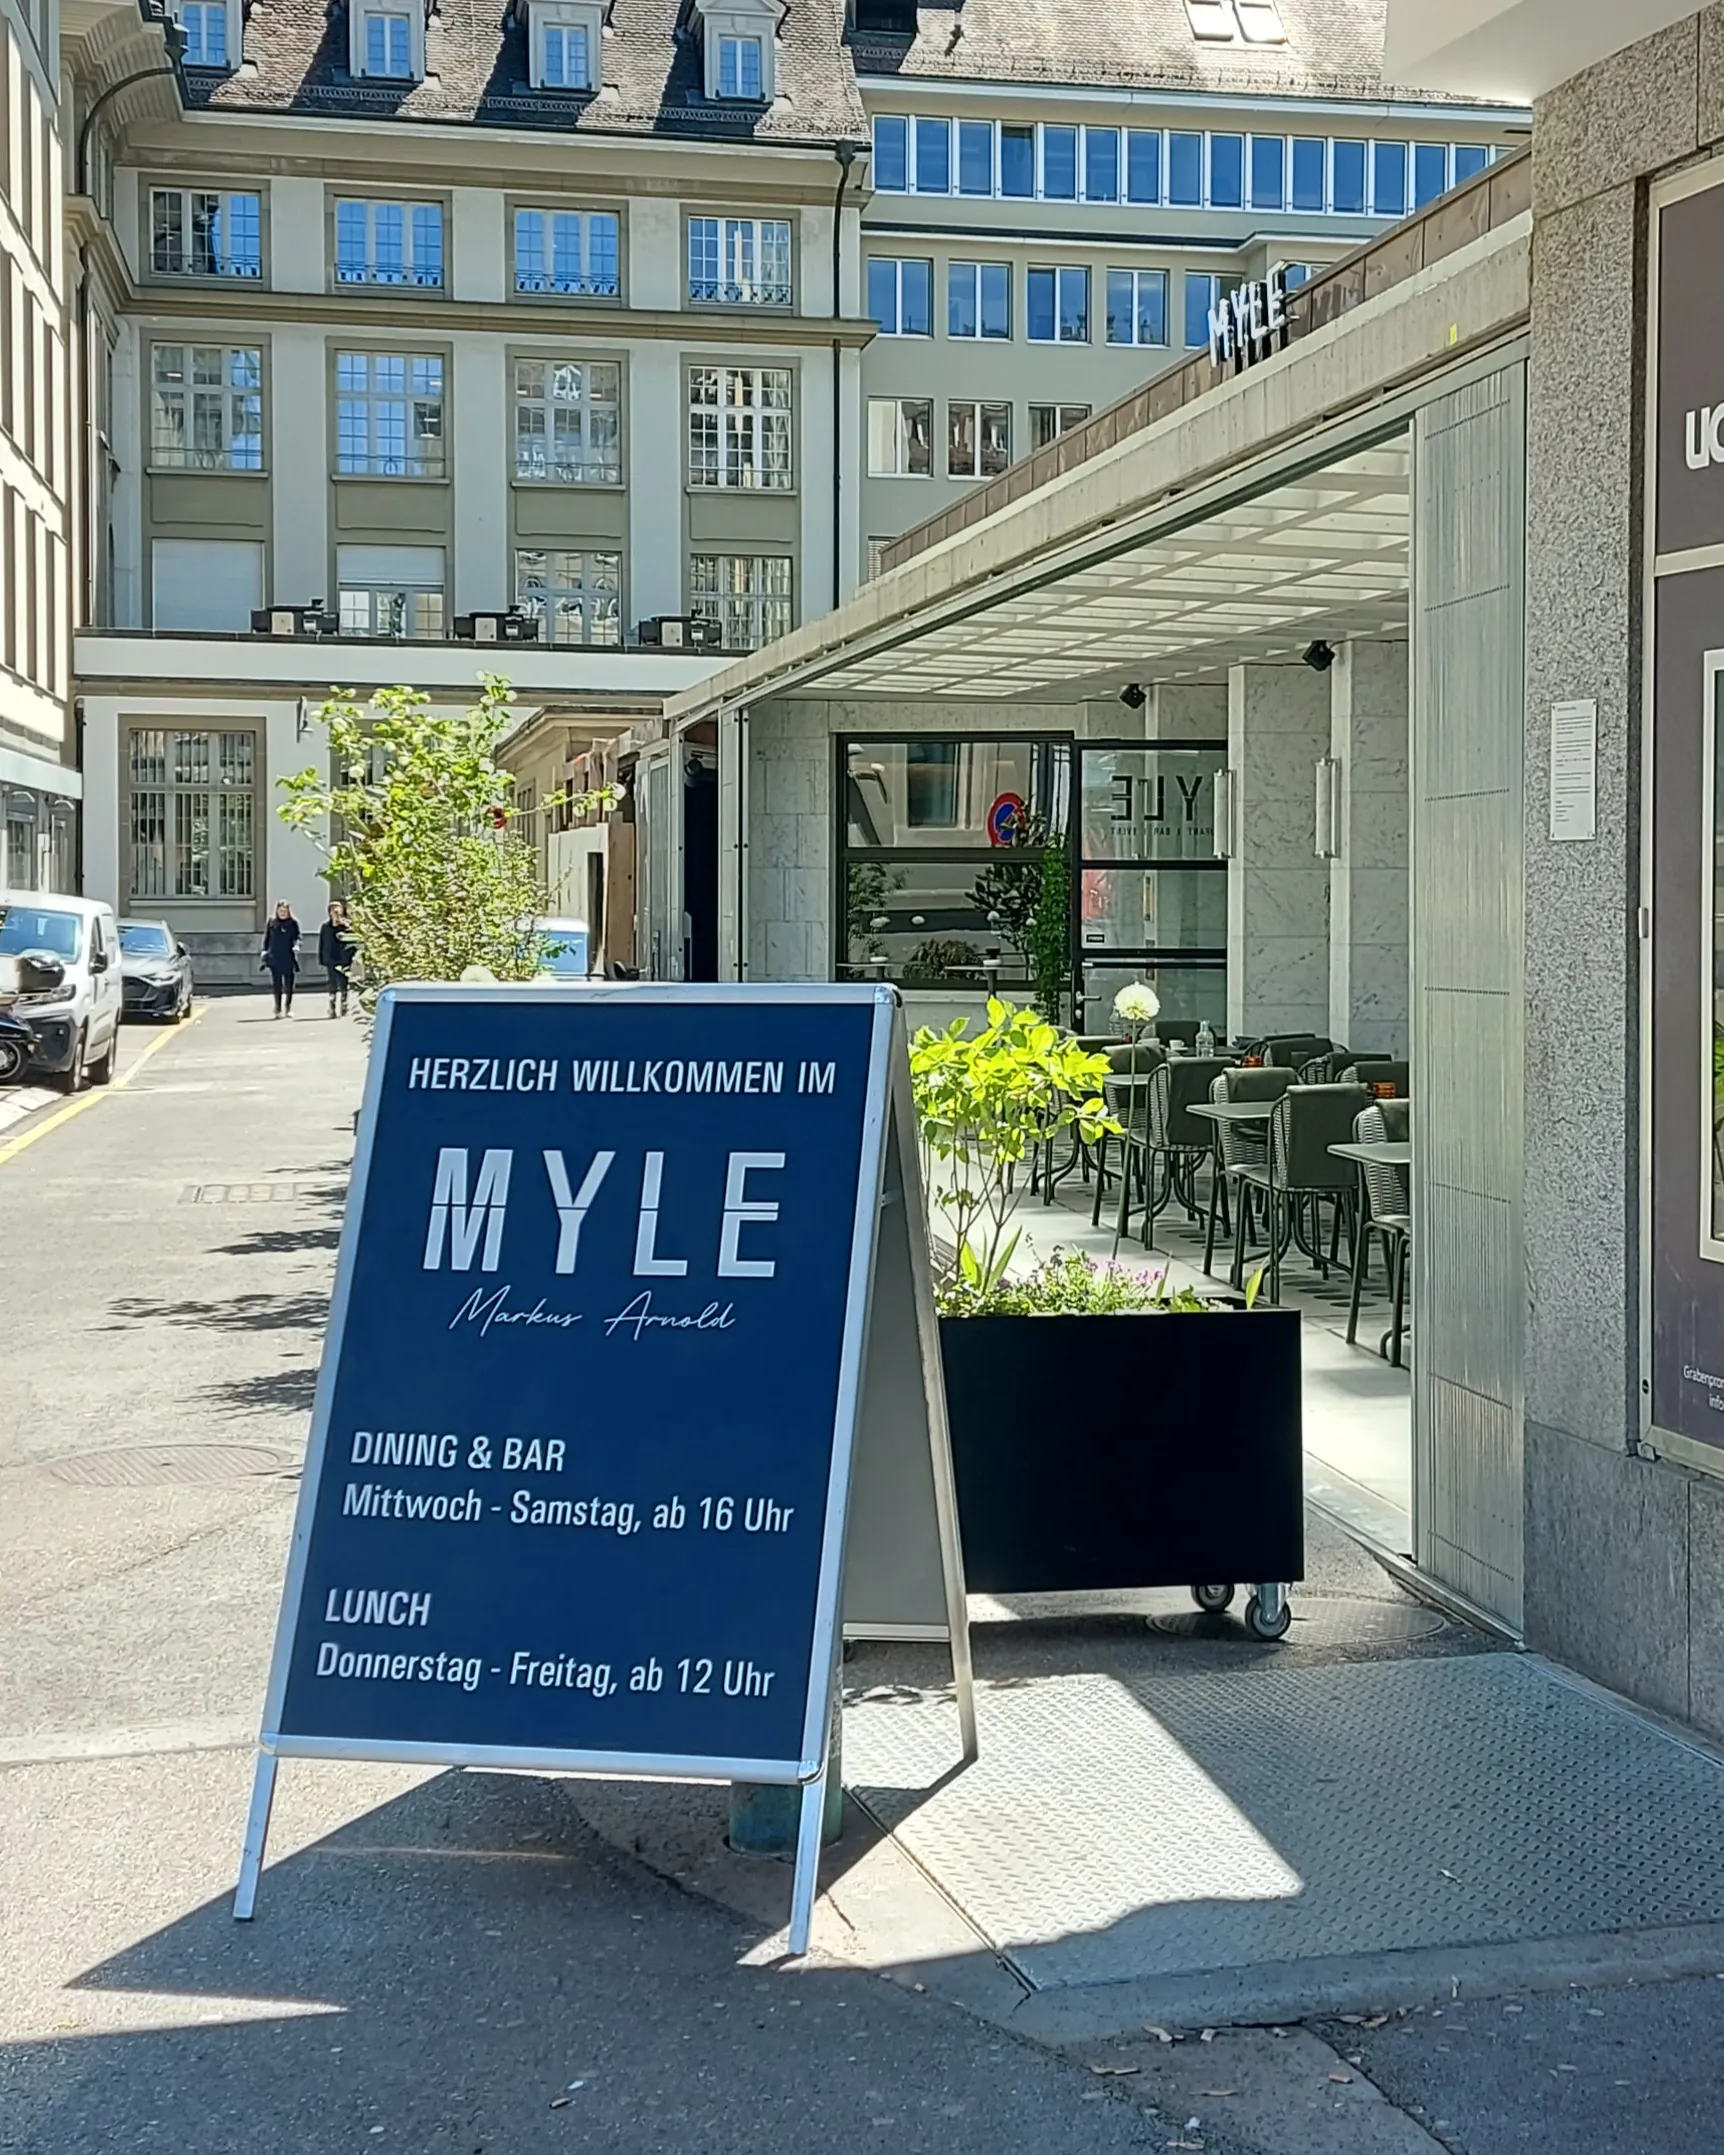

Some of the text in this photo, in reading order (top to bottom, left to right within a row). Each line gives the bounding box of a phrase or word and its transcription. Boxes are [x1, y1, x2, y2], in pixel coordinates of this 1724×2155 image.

[1207, 260, 1285, 368] MYLE
[409, 1058, 835, 1093] HERZLICH WILLKOMMEN IM
[423, 1148, 785, 1277] MYLE
[450, 1285, 734, 1340] Markus Arnold
[352, 1432, 565, 1471] DINING & BAR
[343, 1484, 481, 1520] Mittwoch
[511, 1490, 640, 1534] Samstag,
[654, 1496, 685, 1528] ab
[700, 1497, 733, 1530] 16
[745, 1498, 793, 1531] Uhr
[326, 1589, 430, 1625] LUNCH
[317, 1643, 481, 1690] Donnerstag
[510, 1652, 617, 1697] Freitag,
[630, 1658, 662, 1691] ab
[678, 1659, 712, 1693] 12
[724, 1661, 774, 1696] Uhr
